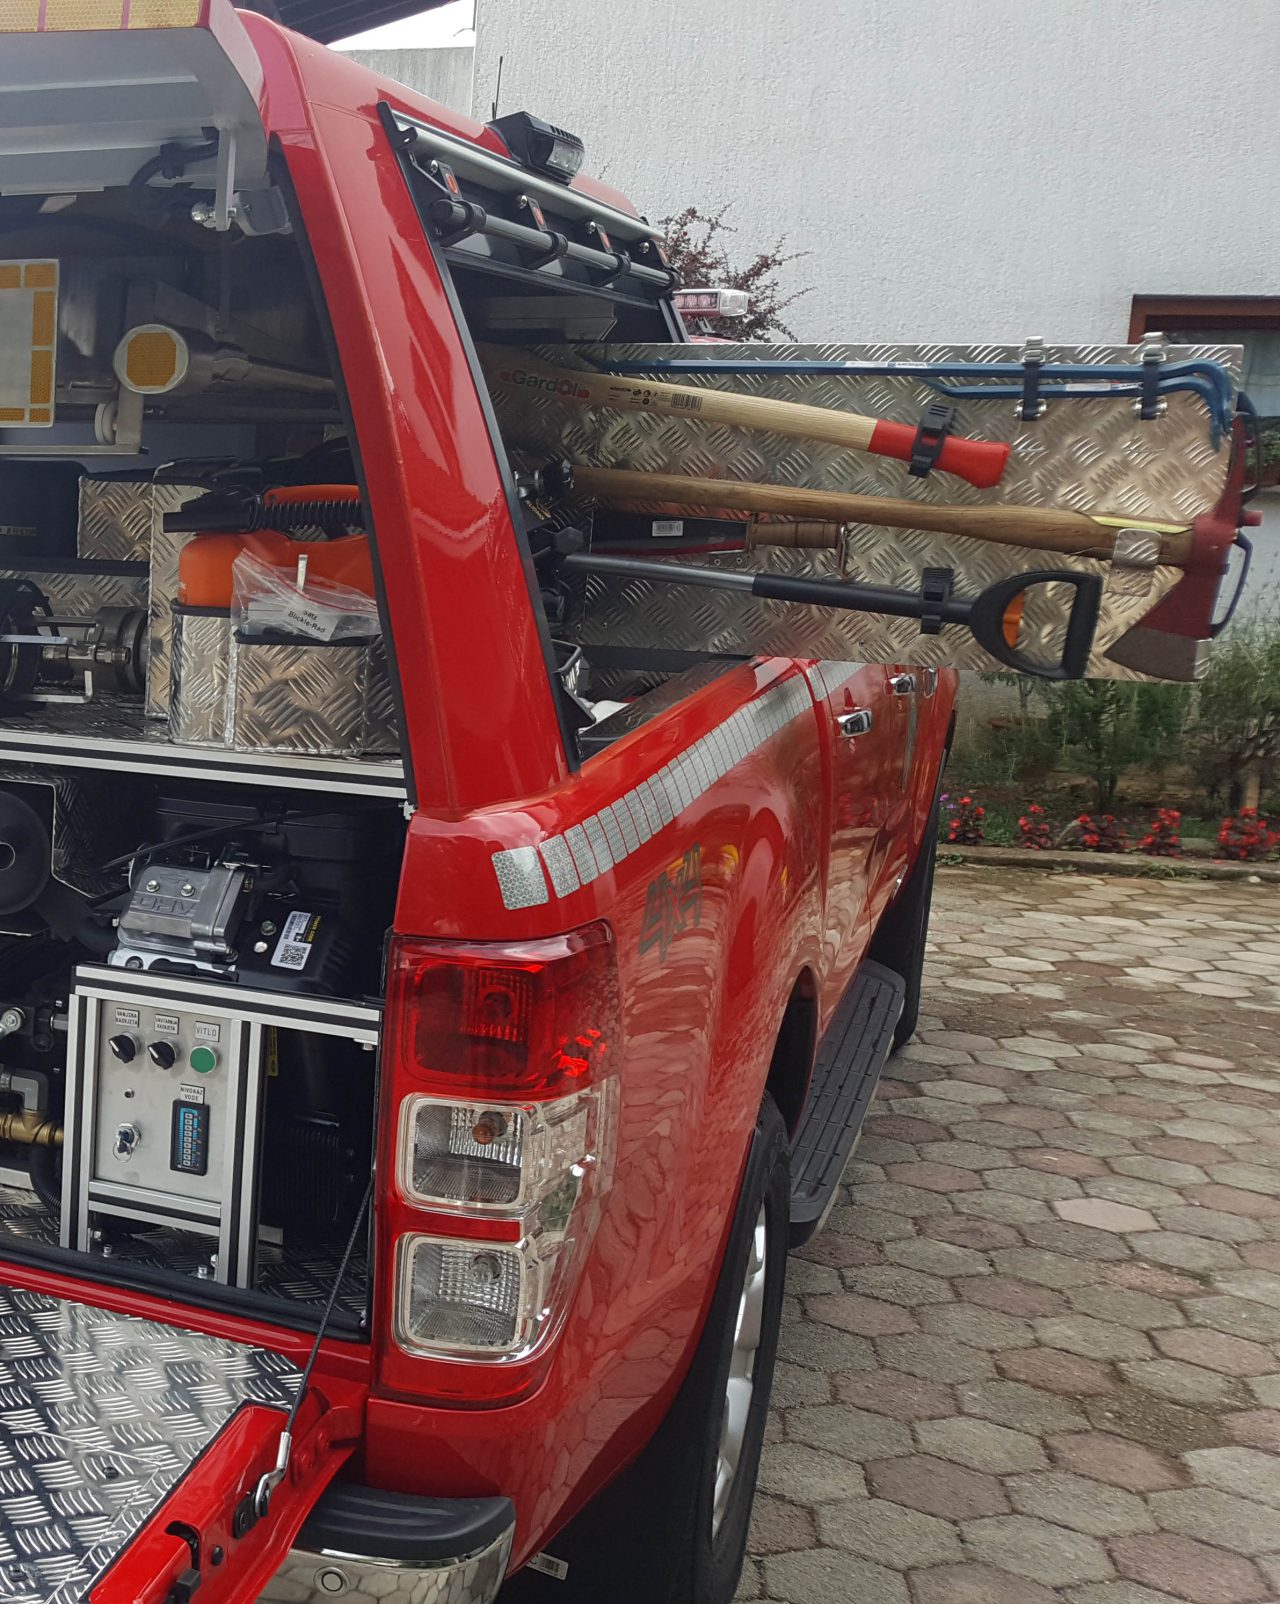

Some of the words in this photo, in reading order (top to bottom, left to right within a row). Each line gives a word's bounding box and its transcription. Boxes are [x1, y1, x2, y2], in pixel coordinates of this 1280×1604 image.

[288, 611, 326, 633] Blickle-Rad
[196, 1026, 217, 1037] VITLO
[180, 1086, 203, 1096] NIVOKAZ
